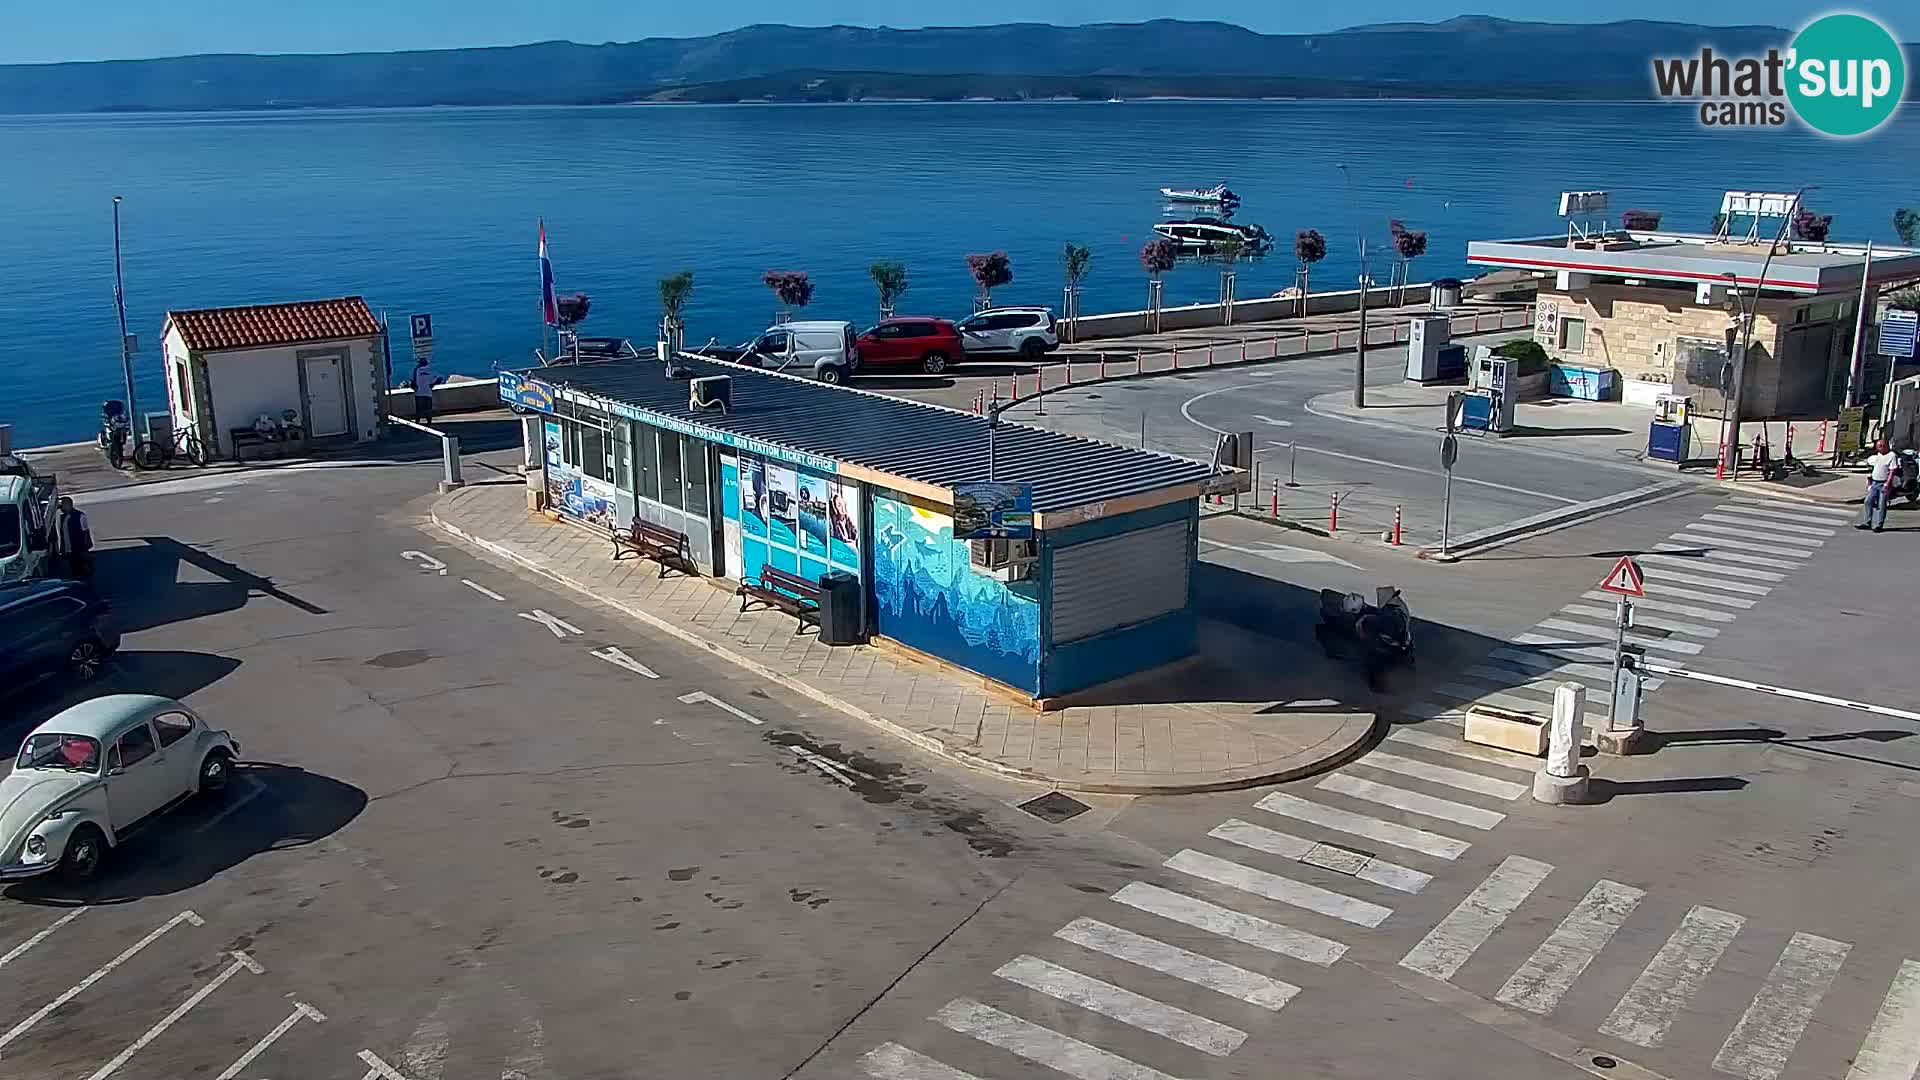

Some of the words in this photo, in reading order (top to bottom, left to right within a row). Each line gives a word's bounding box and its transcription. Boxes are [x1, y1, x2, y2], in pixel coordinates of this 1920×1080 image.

[416, 318, 426, 335] P
[611, 405, 635, 419] PRODAJA
[695, 426, 724, 444] POSTAJA
[734, 435, 747, 450] BUS
[748, 440, 780, 458] STATION
[782, 447, 805, 463] TICKET
[807, 455, 833, 471] OFFICE
